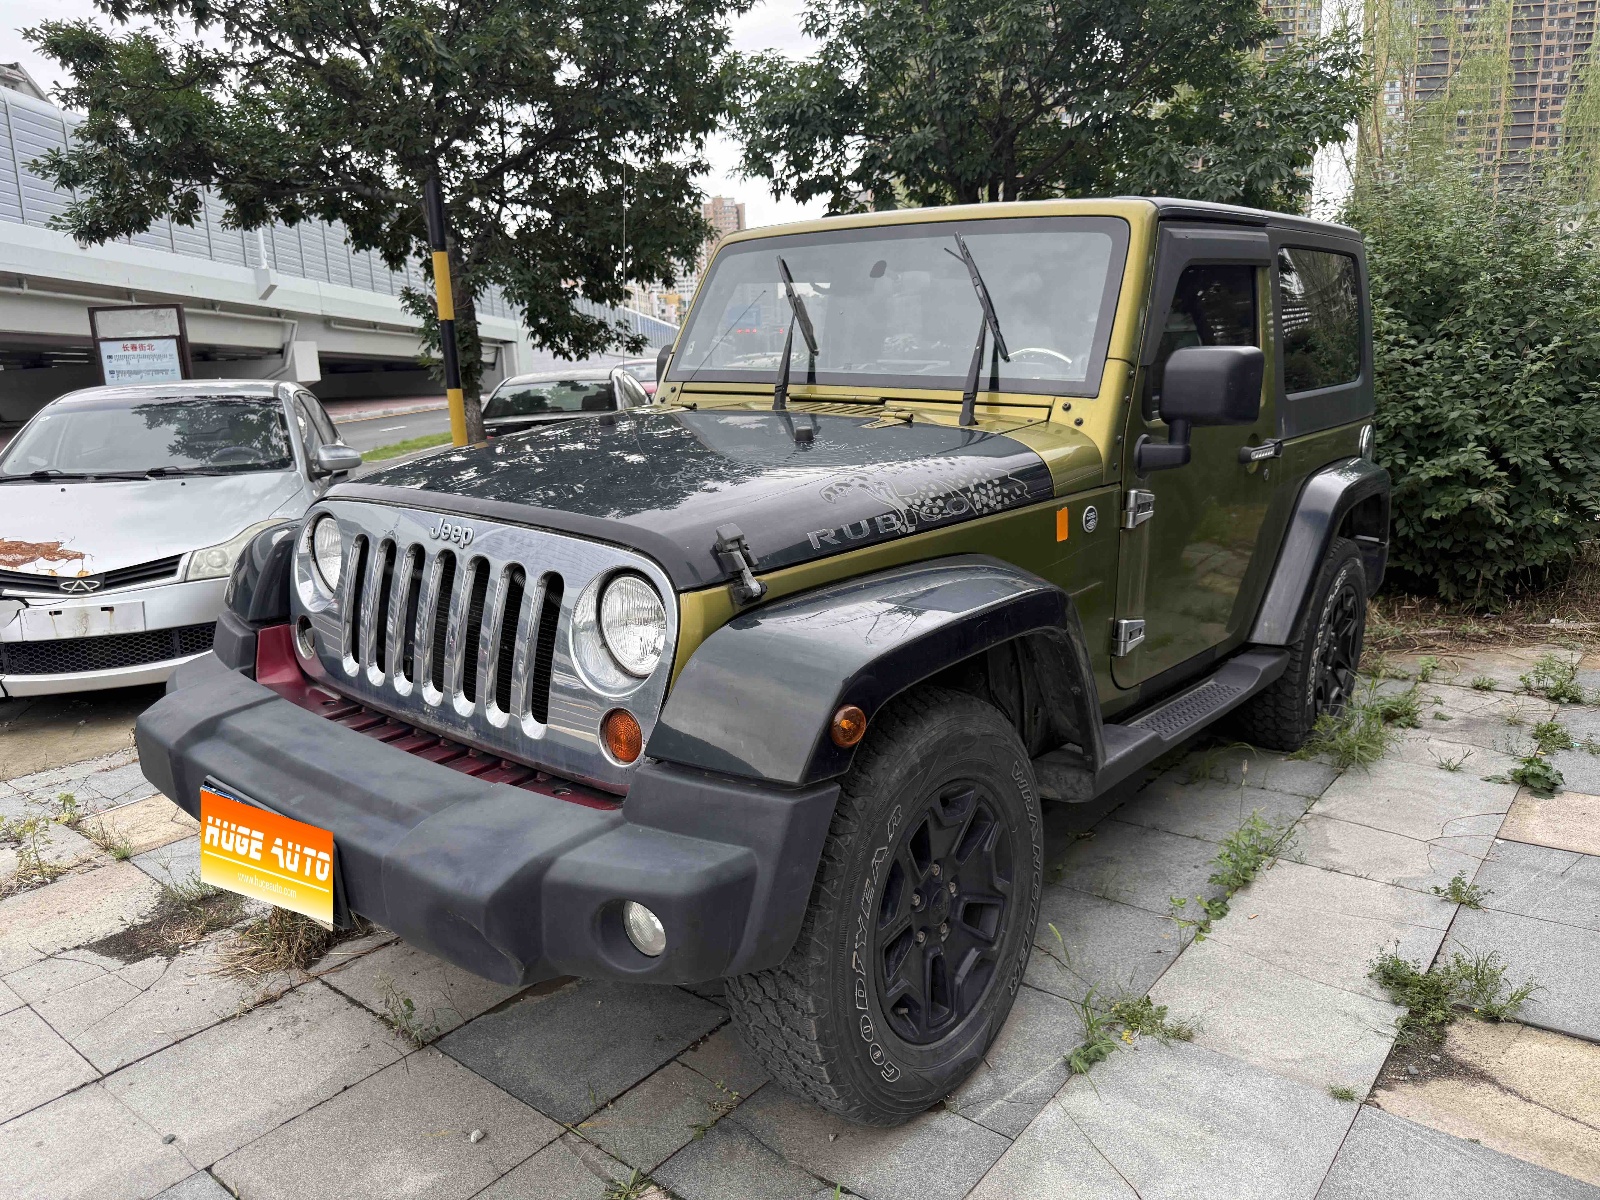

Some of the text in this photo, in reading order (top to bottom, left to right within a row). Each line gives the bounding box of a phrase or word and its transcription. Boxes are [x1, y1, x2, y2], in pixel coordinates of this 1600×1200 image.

[429, 517, 474, 549] Jeep
[852, 803, 902, 1084] GOODYEAR
[1010, 760, 1041, 997] WRANGLER
